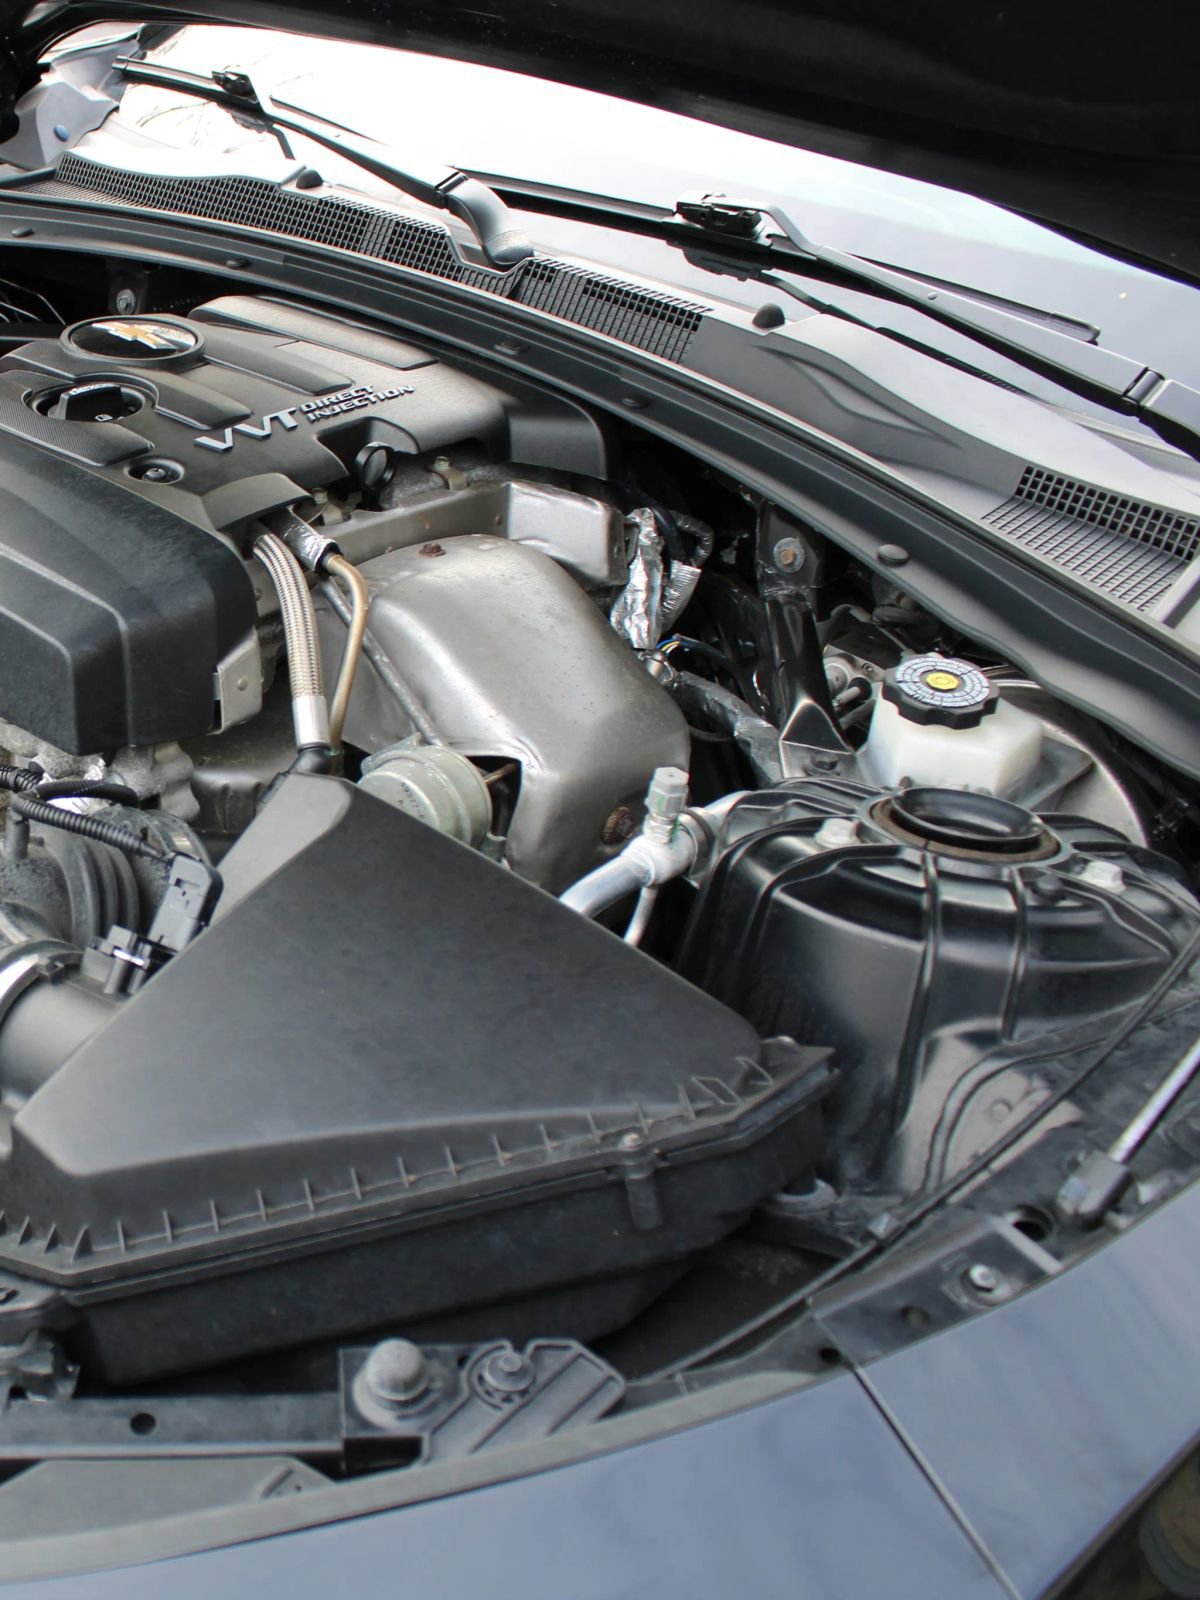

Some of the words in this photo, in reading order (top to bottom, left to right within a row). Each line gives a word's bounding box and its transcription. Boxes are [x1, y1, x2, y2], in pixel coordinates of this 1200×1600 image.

[301, 385, 373, 413] DIRECT
[305, 385, 415, 423] INJECTION
[193, 407, 299, 452] VVT
